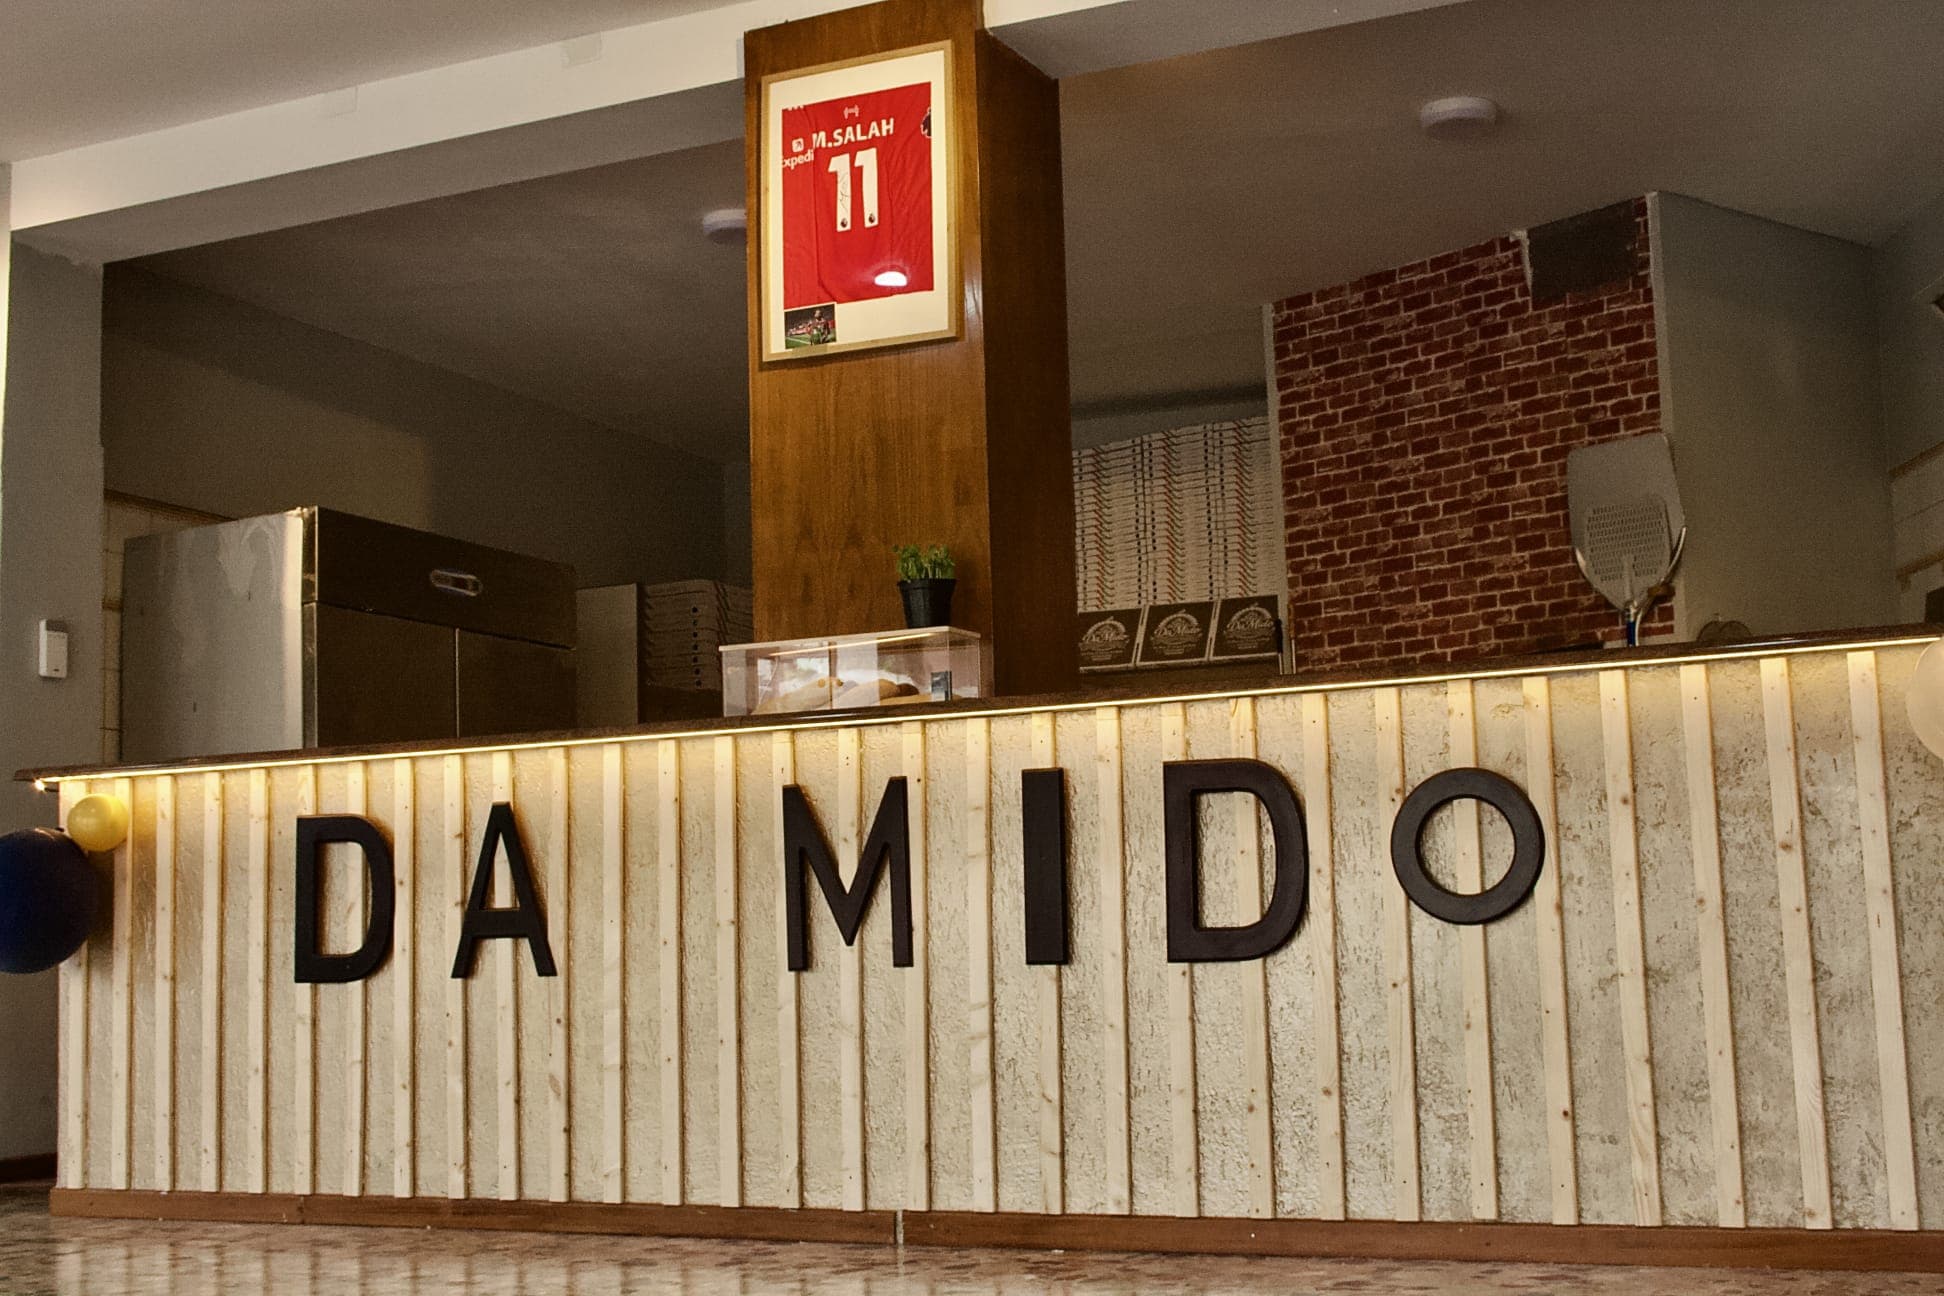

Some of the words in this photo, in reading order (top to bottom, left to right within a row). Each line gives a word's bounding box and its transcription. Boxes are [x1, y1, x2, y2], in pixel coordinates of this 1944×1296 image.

[782, 149, 815, 171] xpedi
[811, 117, 895, 149] M.SALAH
[827, 147, 879, 232] 11
[294, 801, 557, 984] DA
[782, 757, 1545, 972] MIDO
